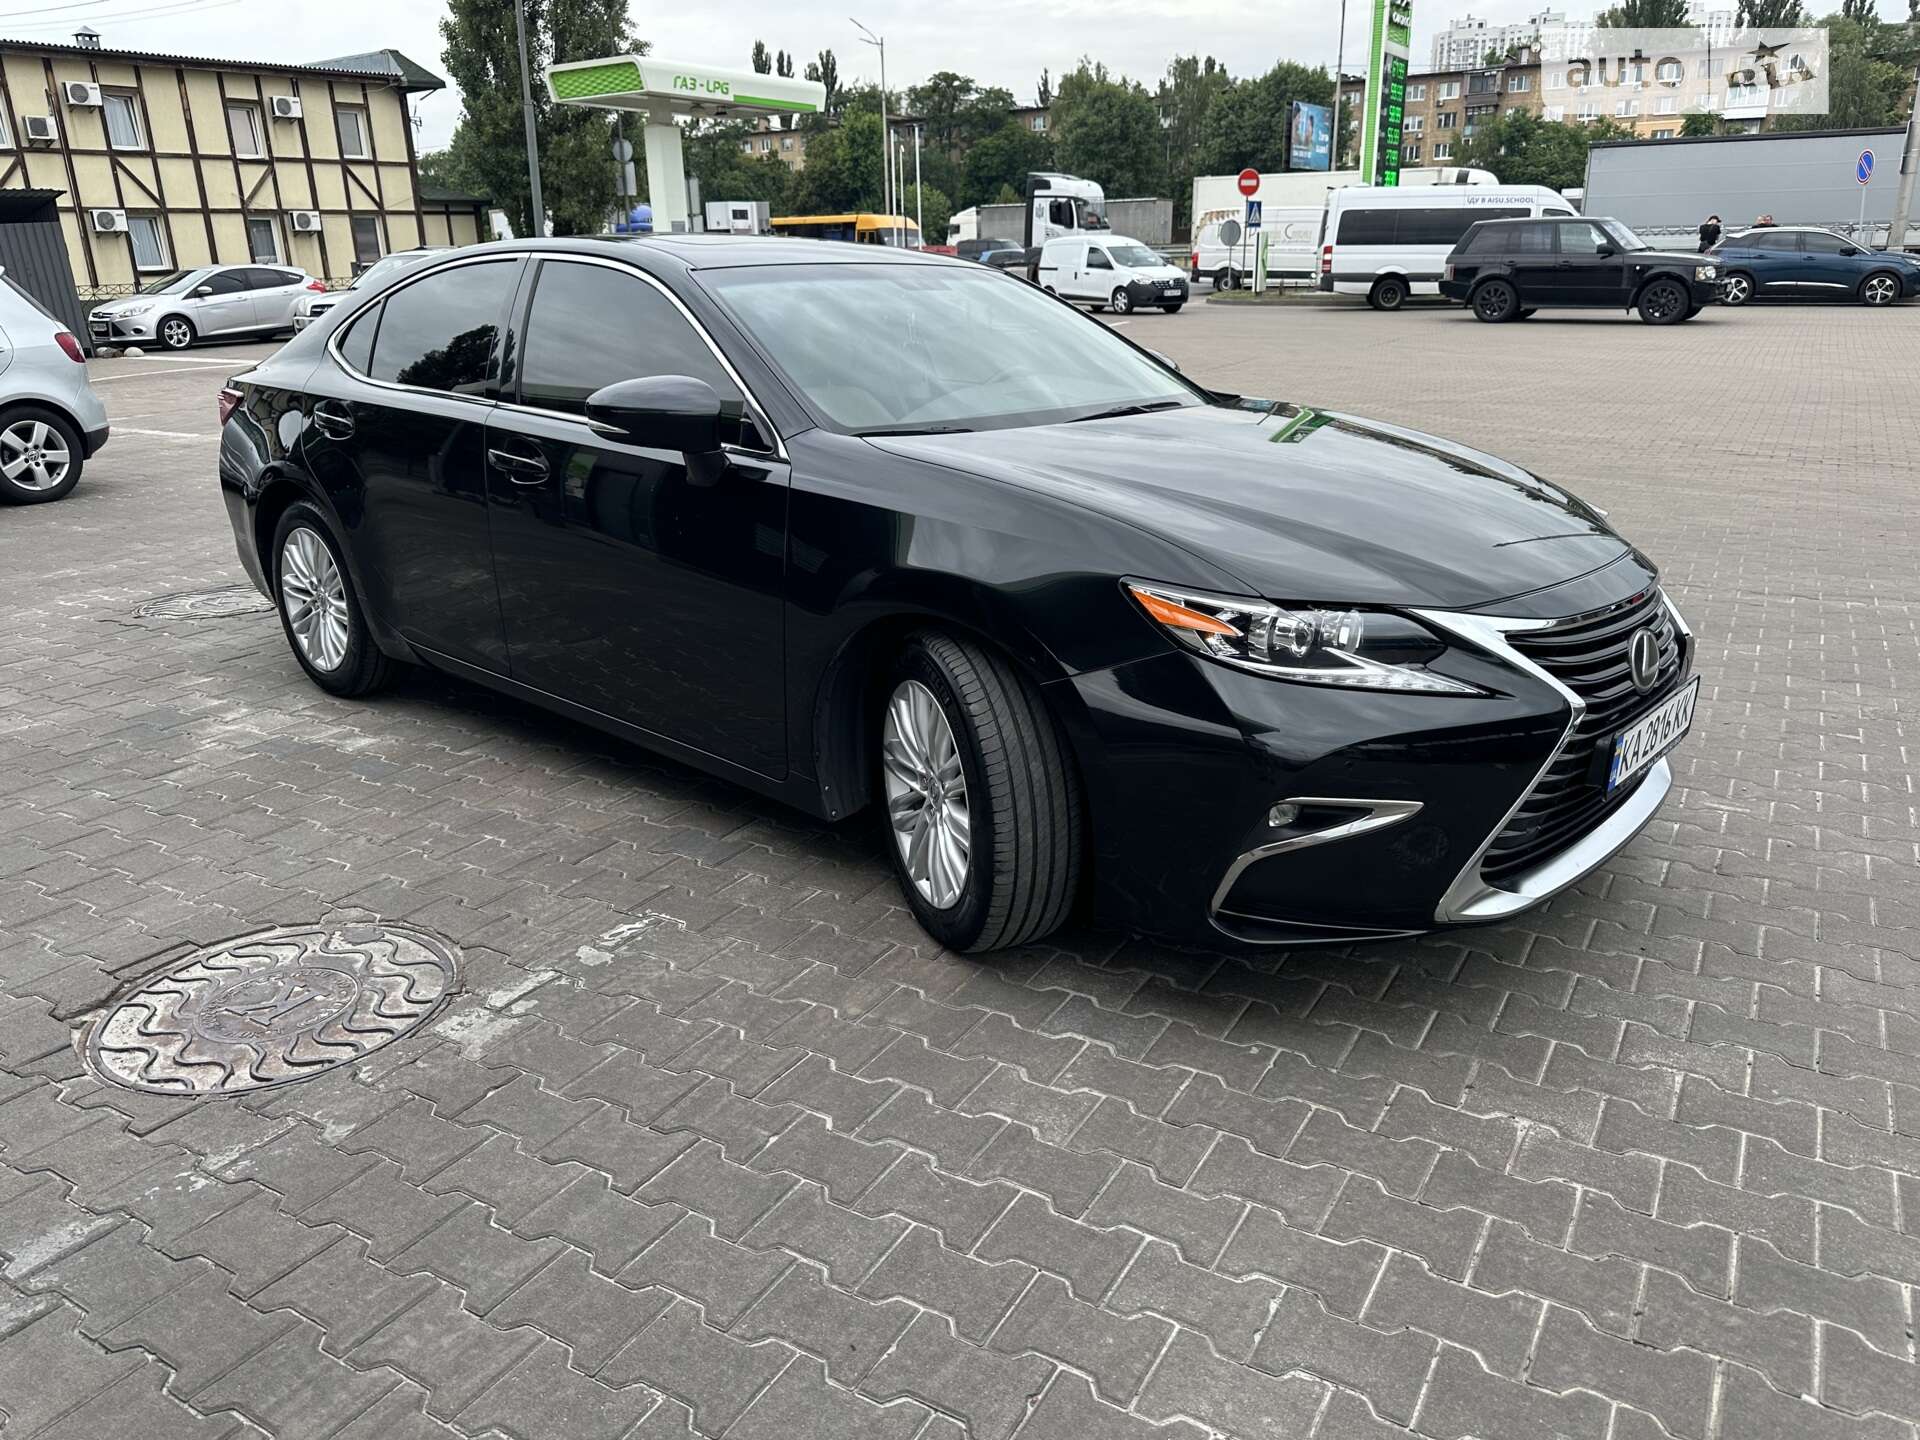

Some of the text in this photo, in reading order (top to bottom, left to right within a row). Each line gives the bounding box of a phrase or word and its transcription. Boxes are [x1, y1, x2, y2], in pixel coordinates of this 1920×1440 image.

[1619, 729, 1641, 777] KA
[1642, 704, 1674, 758] 2816
[1672, 688, 1694, 732] KK
